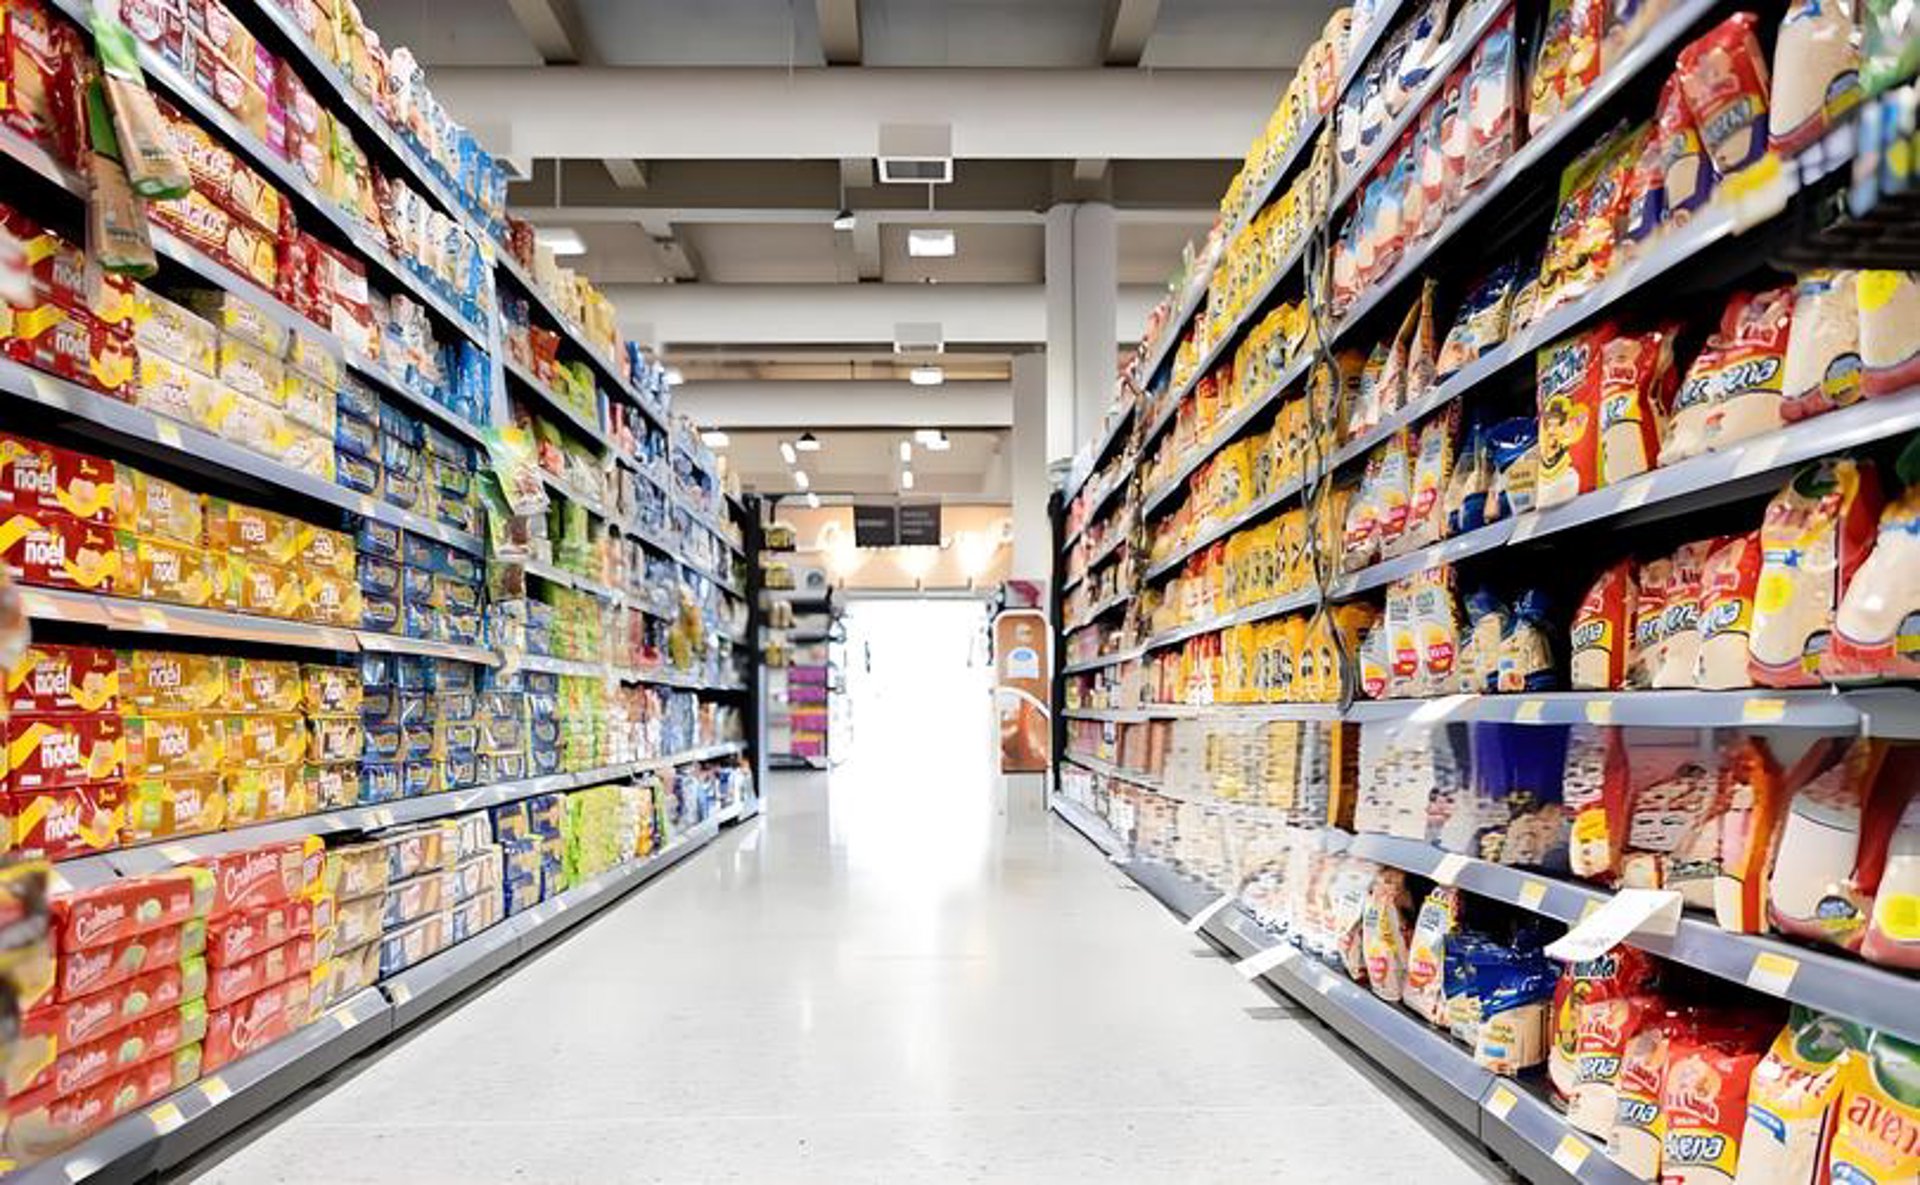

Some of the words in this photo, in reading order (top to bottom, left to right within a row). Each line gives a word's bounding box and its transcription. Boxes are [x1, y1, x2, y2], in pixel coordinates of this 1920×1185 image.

[14, 466, 57, 493] noel
[25, 535, 65, 566] noel
[35, 665, 71, 694] noel
[42, 734, 80, 768] noel
[45, 804, 81, 841] noel
[1848, 1095, 1920, 1156] aven
